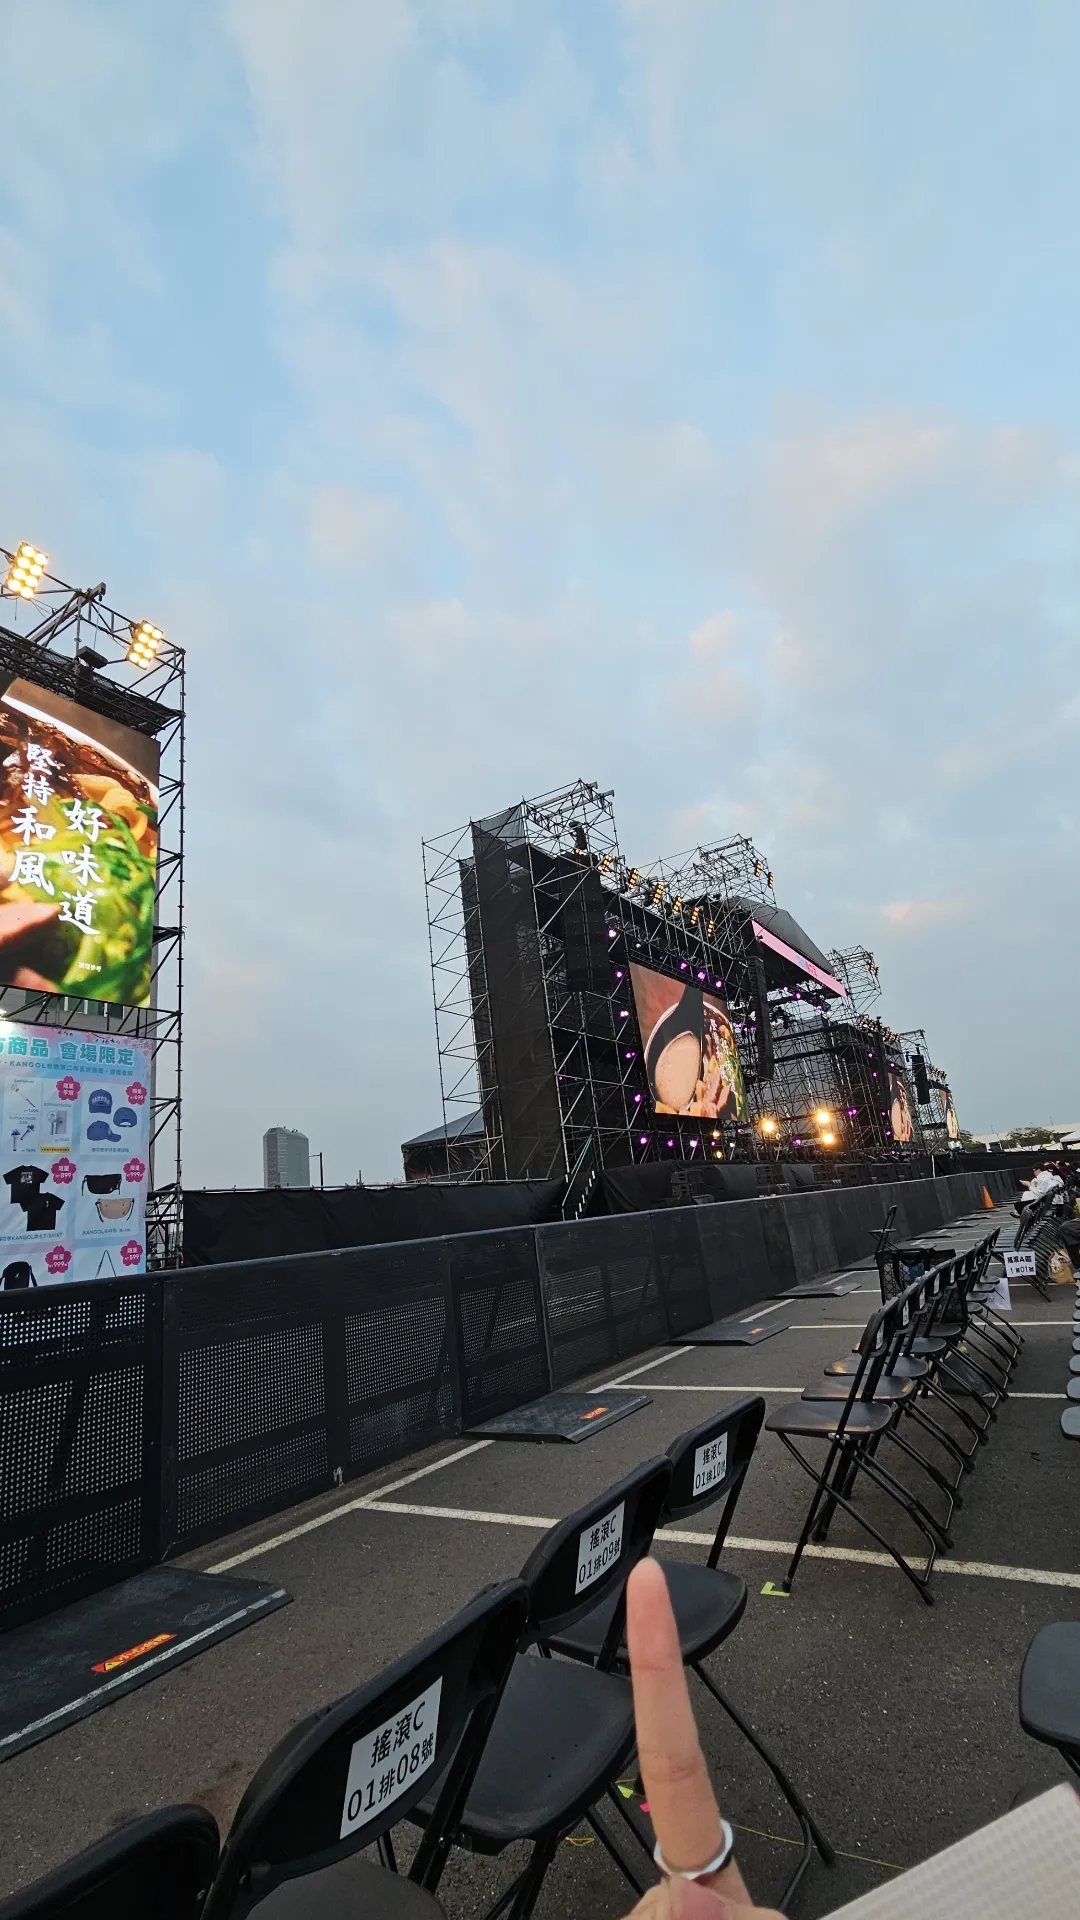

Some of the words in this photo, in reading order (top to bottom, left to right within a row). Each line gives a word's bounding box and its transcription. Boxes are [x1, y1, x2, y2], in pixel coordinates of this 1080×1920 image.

[8, 742, 57, 896] 堅持和風
[58, 797, 108, 936] 好味道
[60, 1042, 134, 1066] 會場限定
[578, 1537, 621, 1584] 01排09號
[589, 1515, 617, 1552] 搖滾C
[371, 1701, 426, 1768] 搖滾C
[347, 1732, 434, 1822] 01排08號
